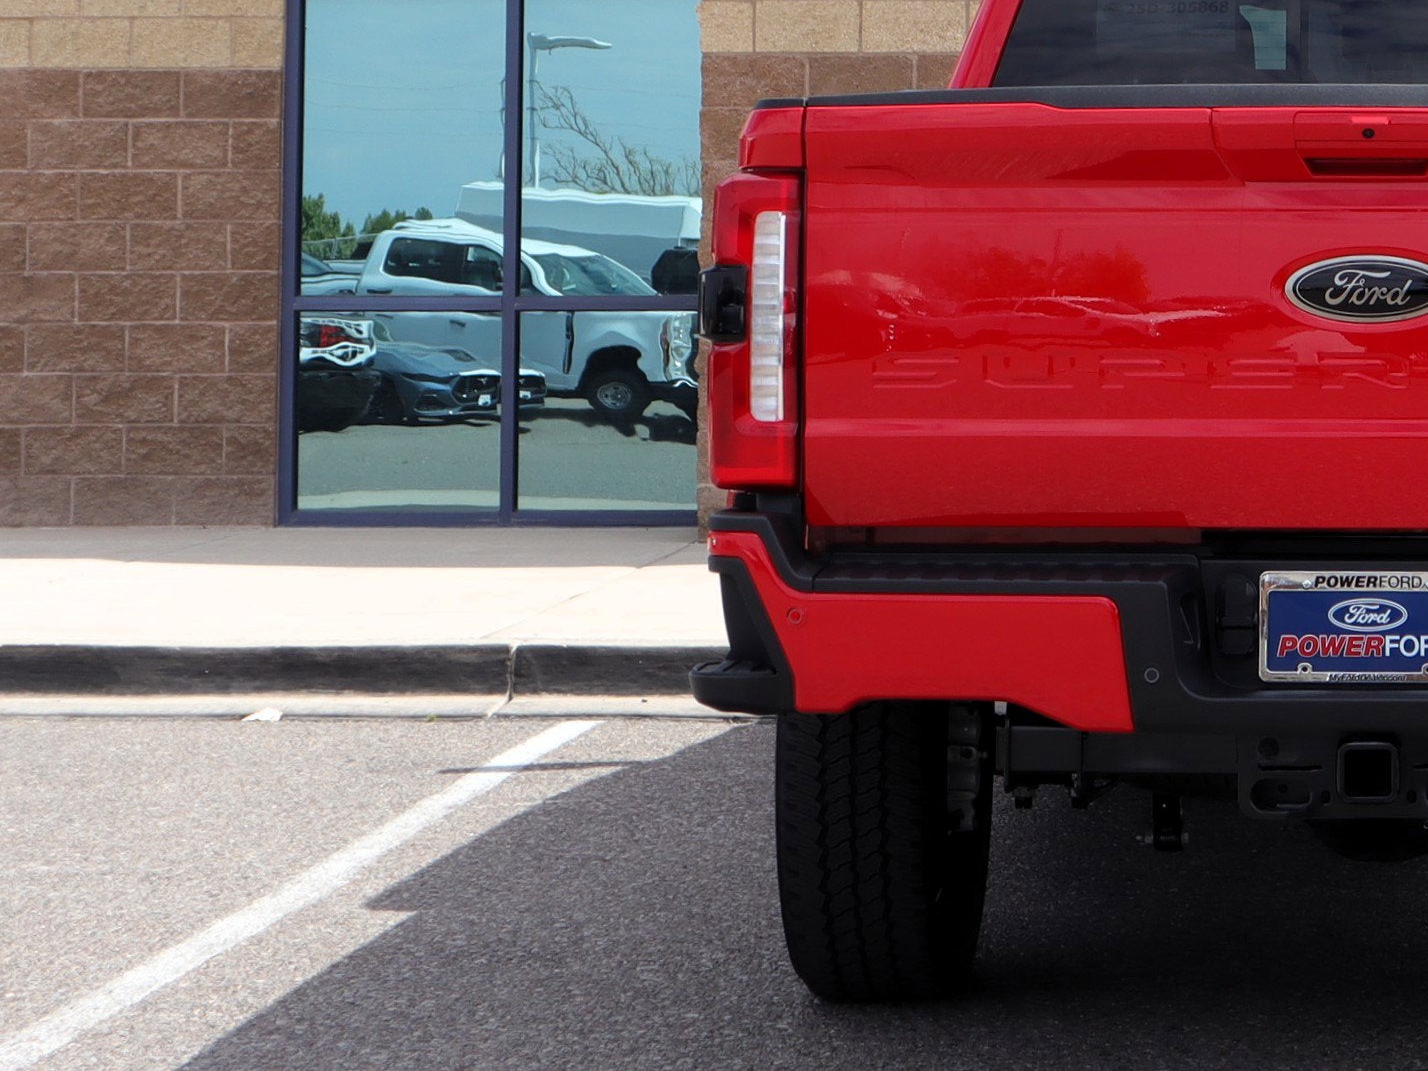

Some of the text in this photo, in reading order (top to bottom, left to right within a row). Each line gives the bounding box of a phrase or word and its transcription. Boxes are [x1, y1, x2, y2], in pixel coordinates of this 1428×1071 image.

[1325, 269, 1413, 305] Ford
[872, 353, 1409, 389] SUPER
[1344, 604, 1391, 625] Ford
